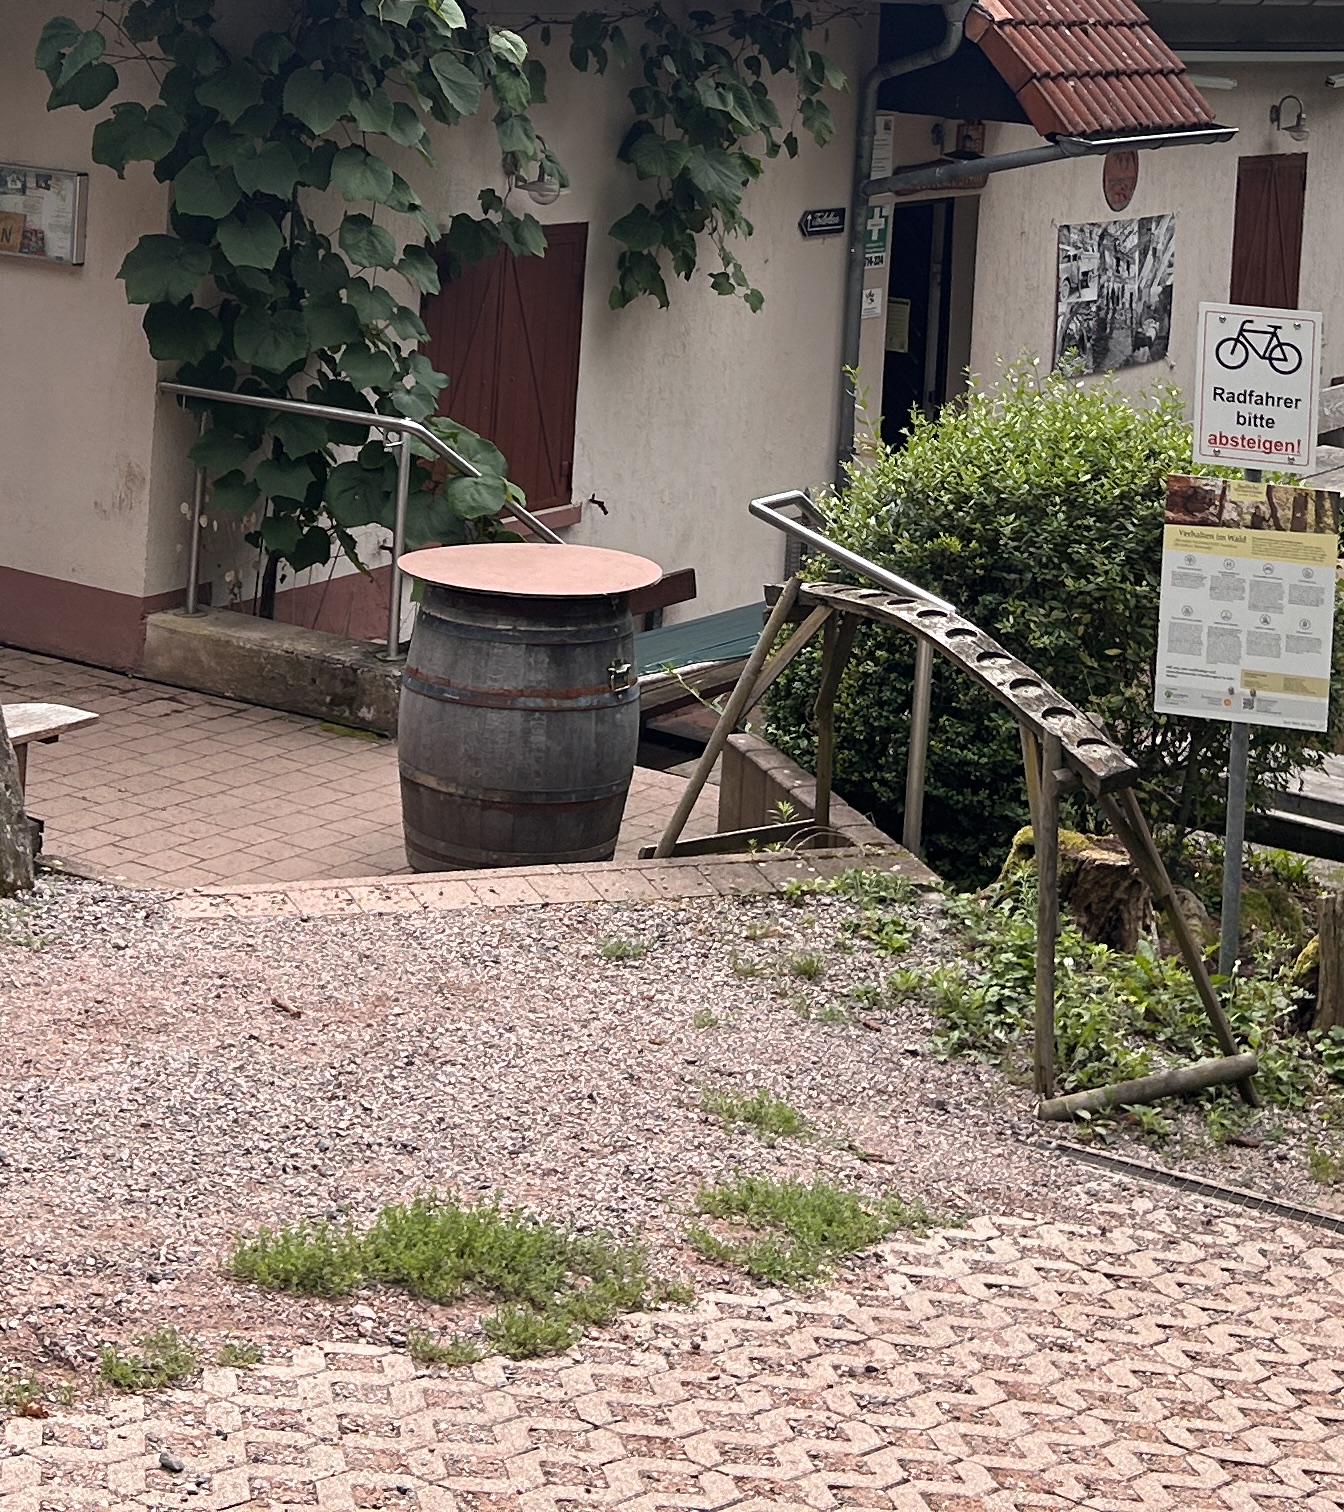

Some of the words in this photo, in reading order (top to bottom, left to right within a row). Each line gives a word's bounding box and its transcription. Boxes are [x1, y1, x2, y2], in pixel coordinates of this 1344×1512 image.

[1212, 386, 1302, 409] Radfahrer
[1236, 410, 1275, 429] bitte
[1207, 431, 1301, 455] absteigen!
[1227, 534, 1247, 543] Wald
